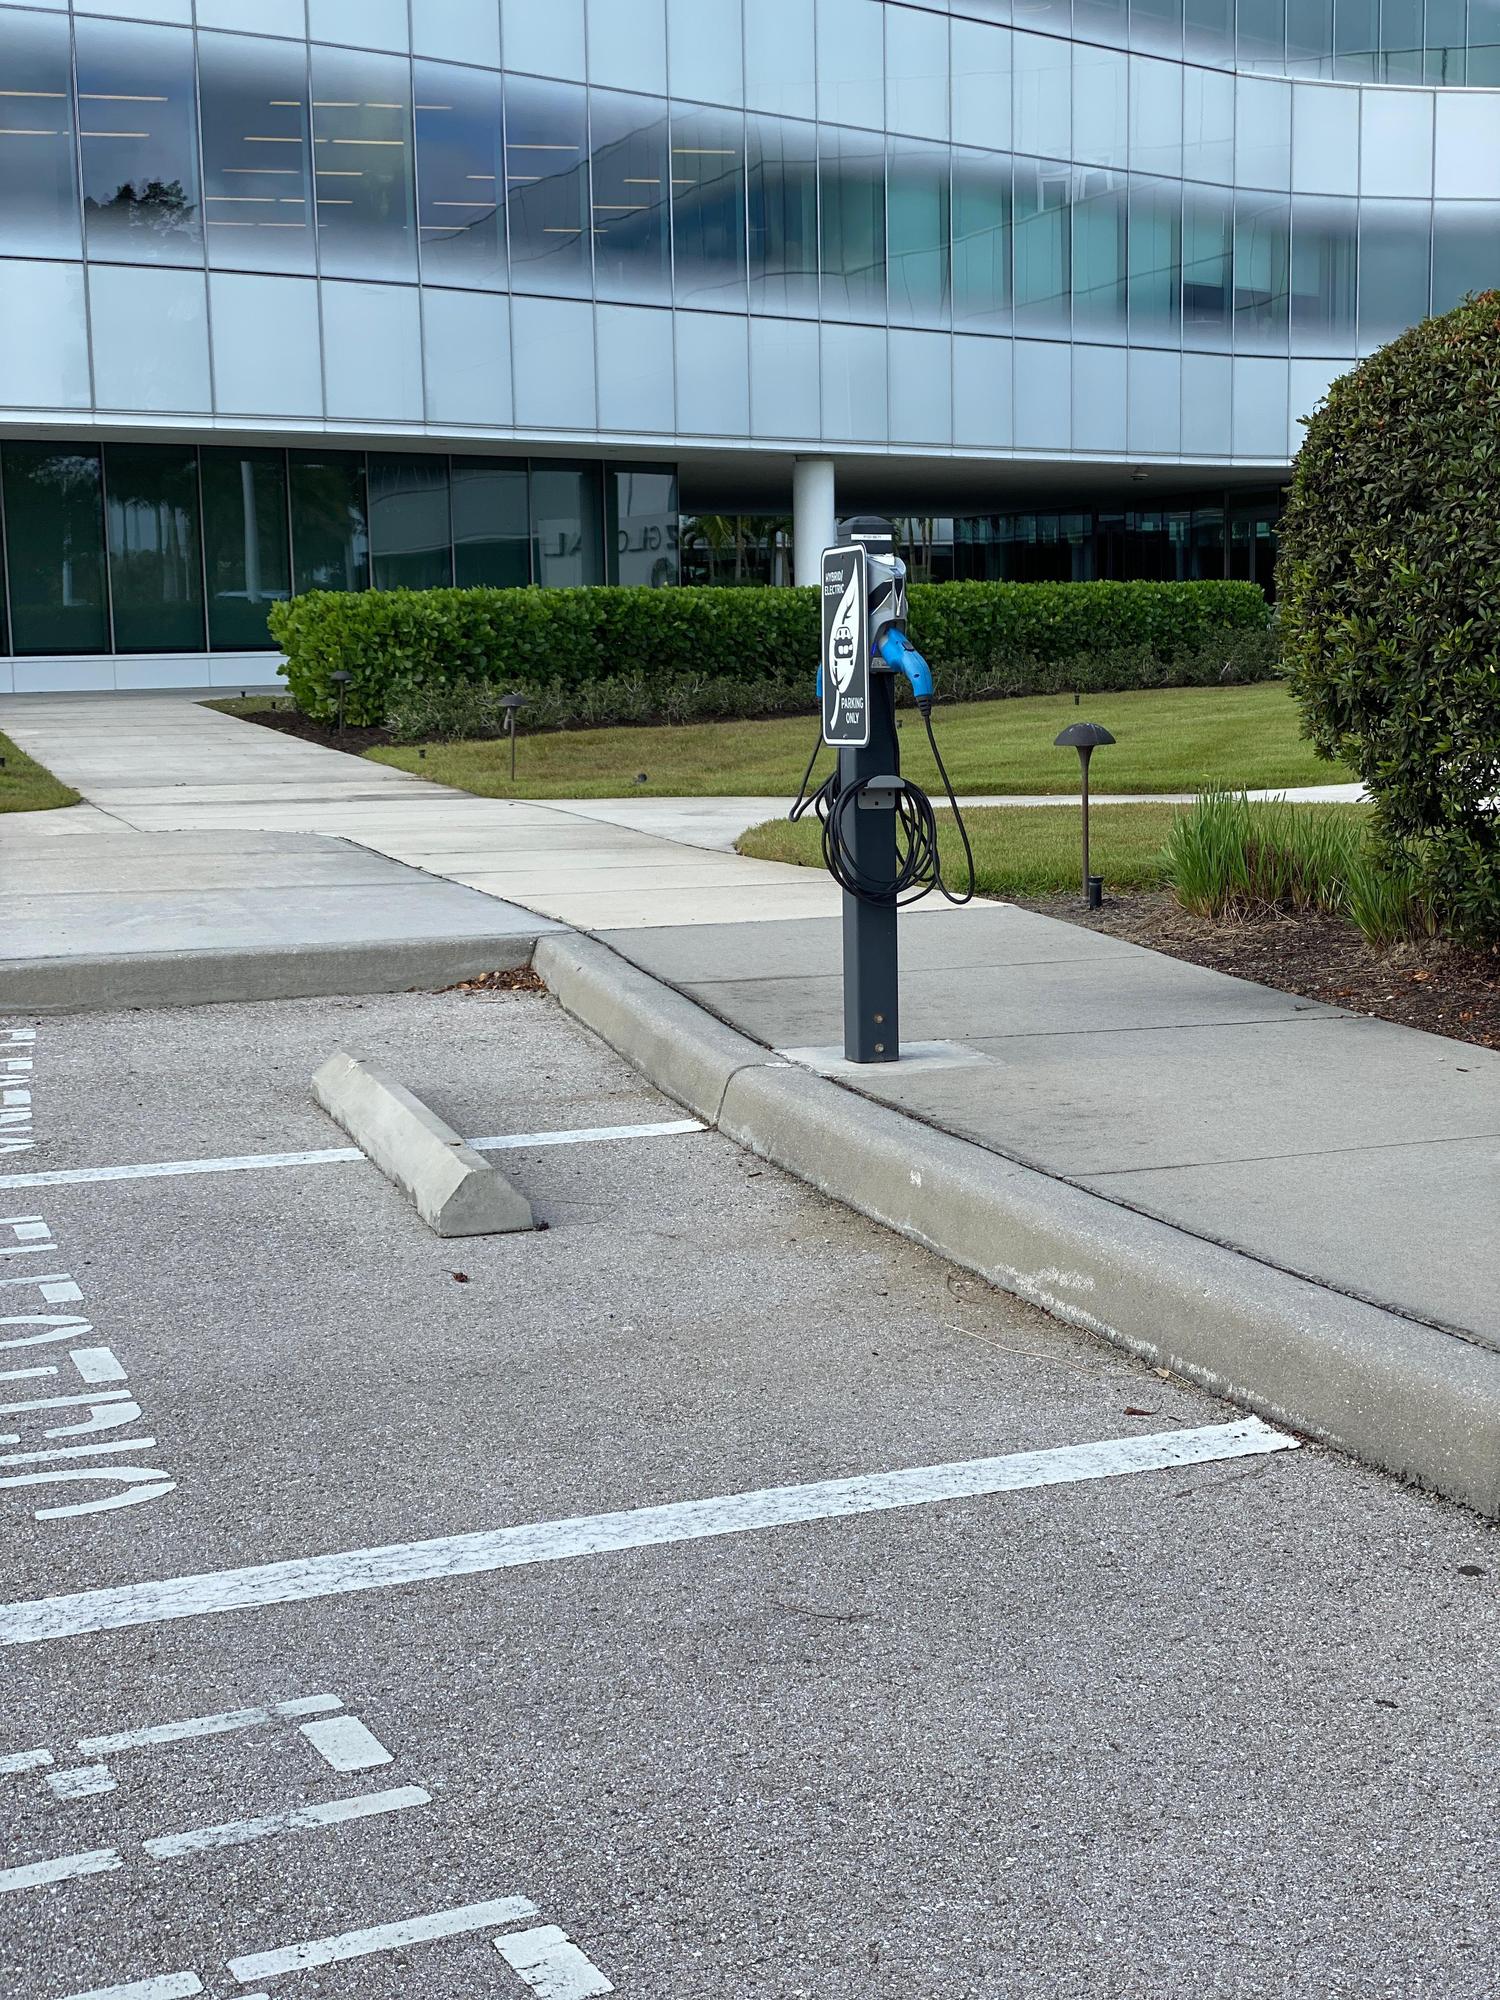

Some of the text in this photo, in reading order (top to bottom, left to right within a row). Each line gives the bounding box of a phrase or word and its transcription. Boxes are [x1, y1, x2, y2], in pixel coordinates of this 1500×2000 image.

[824, 583, 845, 596] ELECTRIC
[841, 696, 864, 709] PARKING
[845, 711, 860, 724] ONLY
